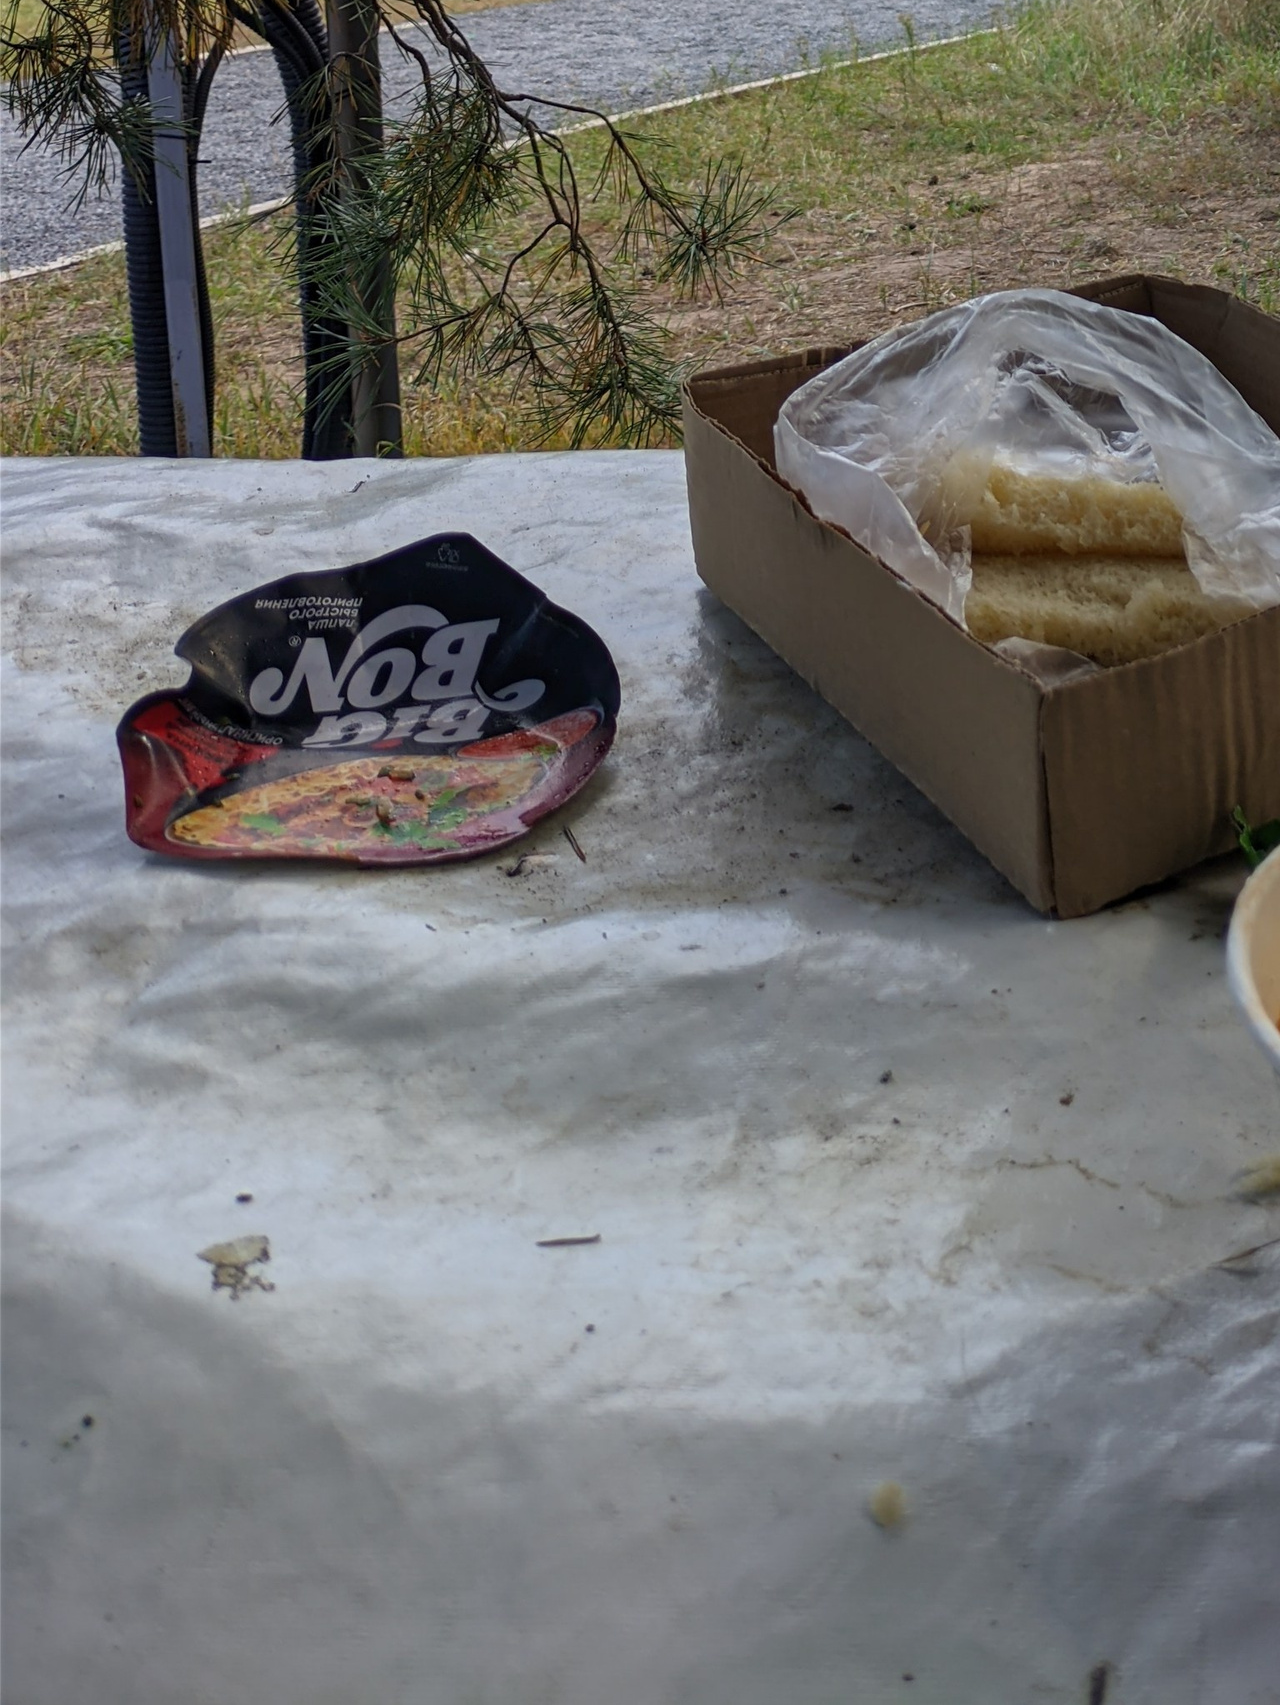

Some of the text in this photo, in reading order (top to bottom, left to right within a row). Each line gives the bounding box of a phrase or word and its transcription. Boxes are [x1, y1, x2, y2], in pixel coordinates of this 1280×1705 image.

[255, 596, 363, 609] ПРИГОТОВЛЕНИЯ
[289, 607, 359, 620] БЫСТРОГО
[307, 618, 355, 630] ЛАПША
[250, 605, 545, 715] BON
